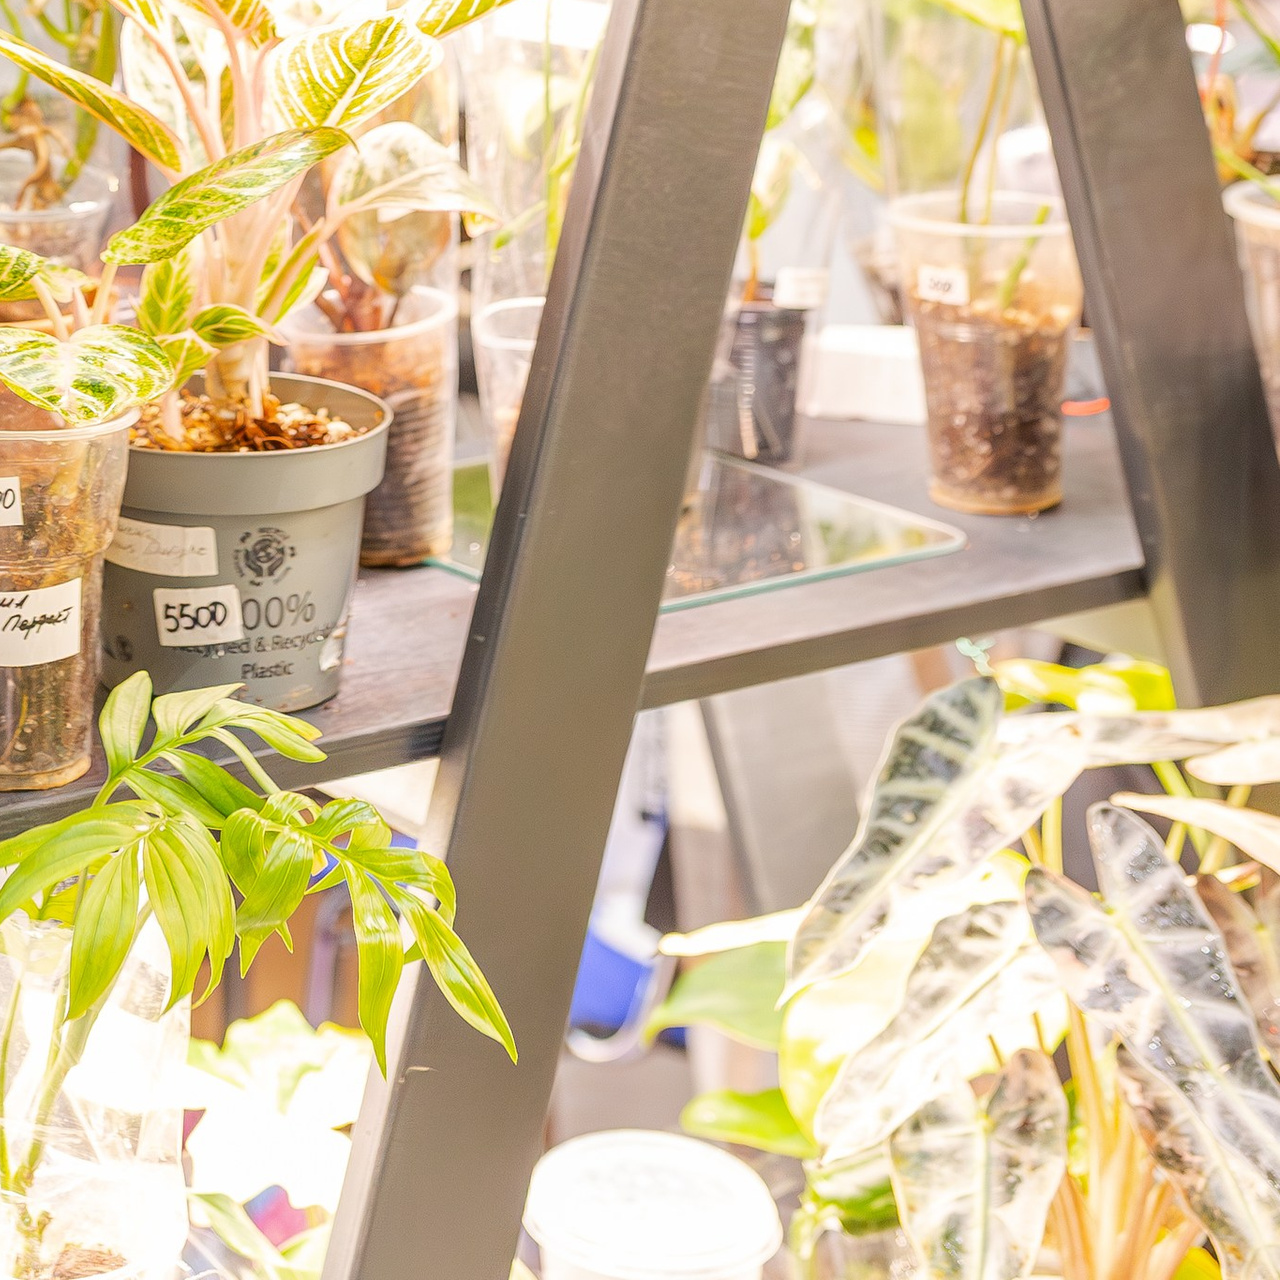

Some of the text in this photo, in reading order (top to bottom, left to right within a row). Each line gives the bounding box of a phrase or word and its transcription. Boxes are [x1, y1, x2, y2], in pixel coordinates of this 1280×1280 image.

[163, 600, 228, 633] 5500
[242, 590, 317, 631] 00%
[240, 660, 295, 680] Plastic
